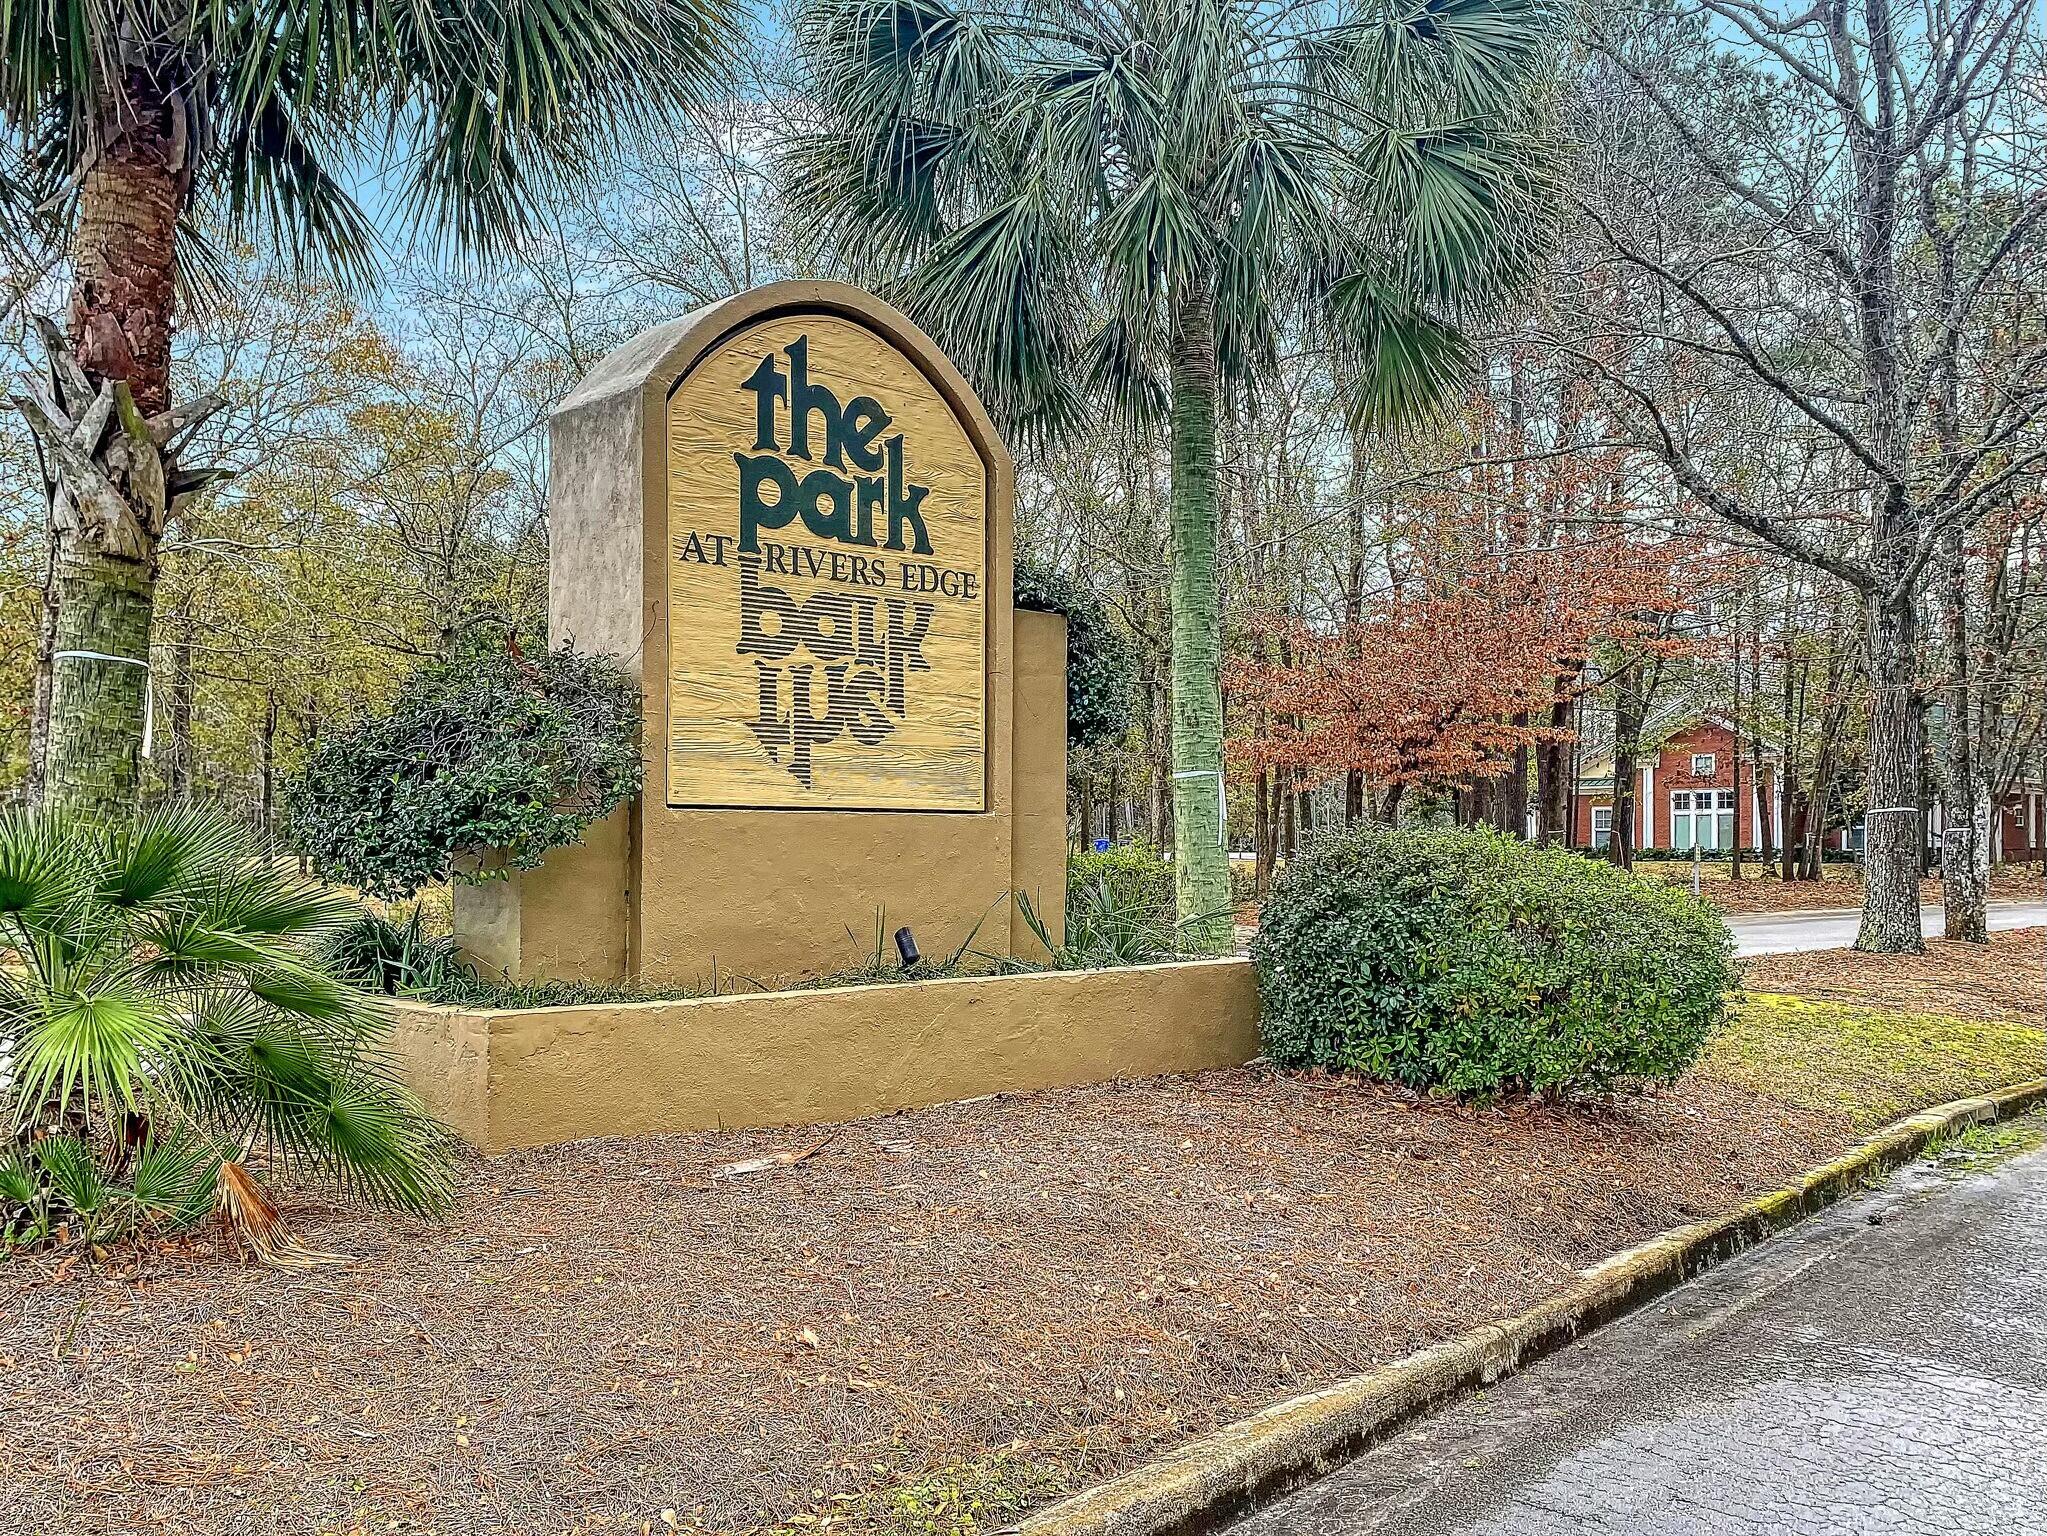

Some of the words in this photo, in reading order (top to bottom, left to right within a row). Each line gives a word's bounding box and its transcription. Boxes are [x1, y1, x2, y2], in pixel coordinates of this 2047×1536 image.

[740, 334, 893, 473] the
[733, 434, 934, 555] park
[679, 531, 735, 567] AT
[763, 543, 887, 586] RIVERS
[900, 562, 979, 600] EDGE
